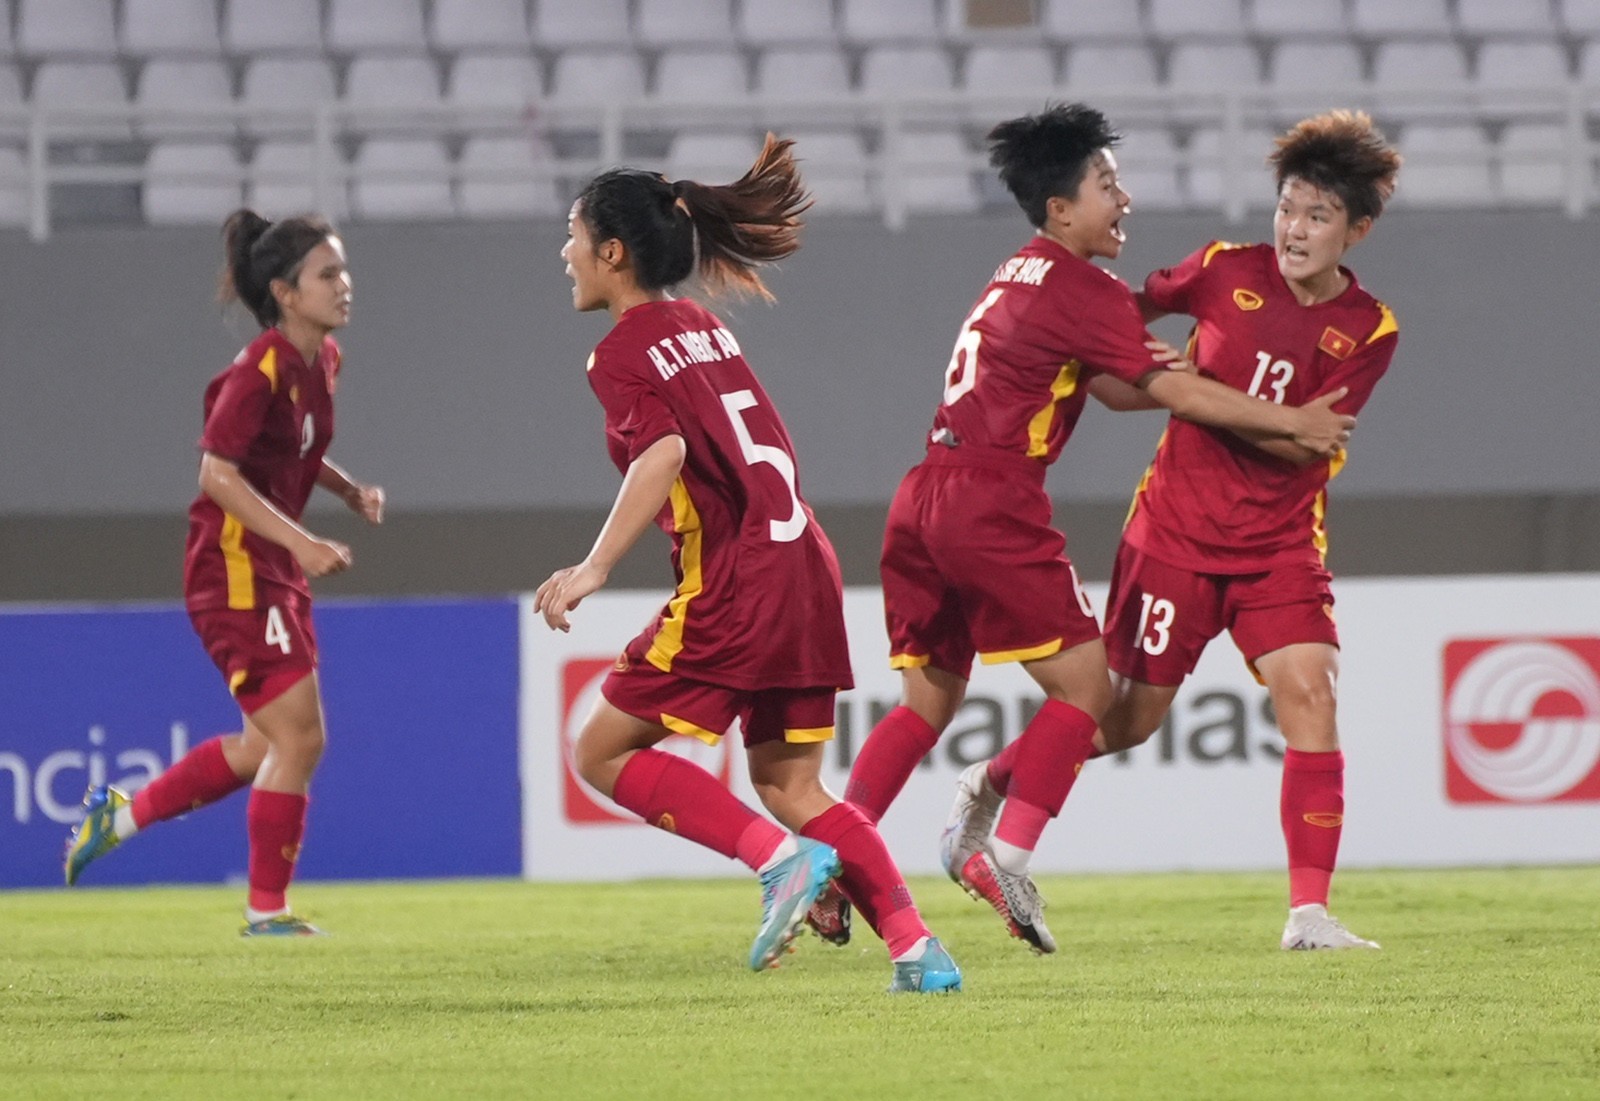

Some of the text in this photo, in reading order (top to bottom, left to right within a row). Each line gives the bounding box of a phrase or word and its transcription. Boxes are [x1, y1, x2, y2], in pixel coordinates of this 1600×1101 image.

[944, 288, 1004, 406] 6
[1247, 350, 1295, 405] 13
[720, 389, 808, 543] 5
[264, 605, 291, 655] 4
[1134, 592, 1176, 656] 13
